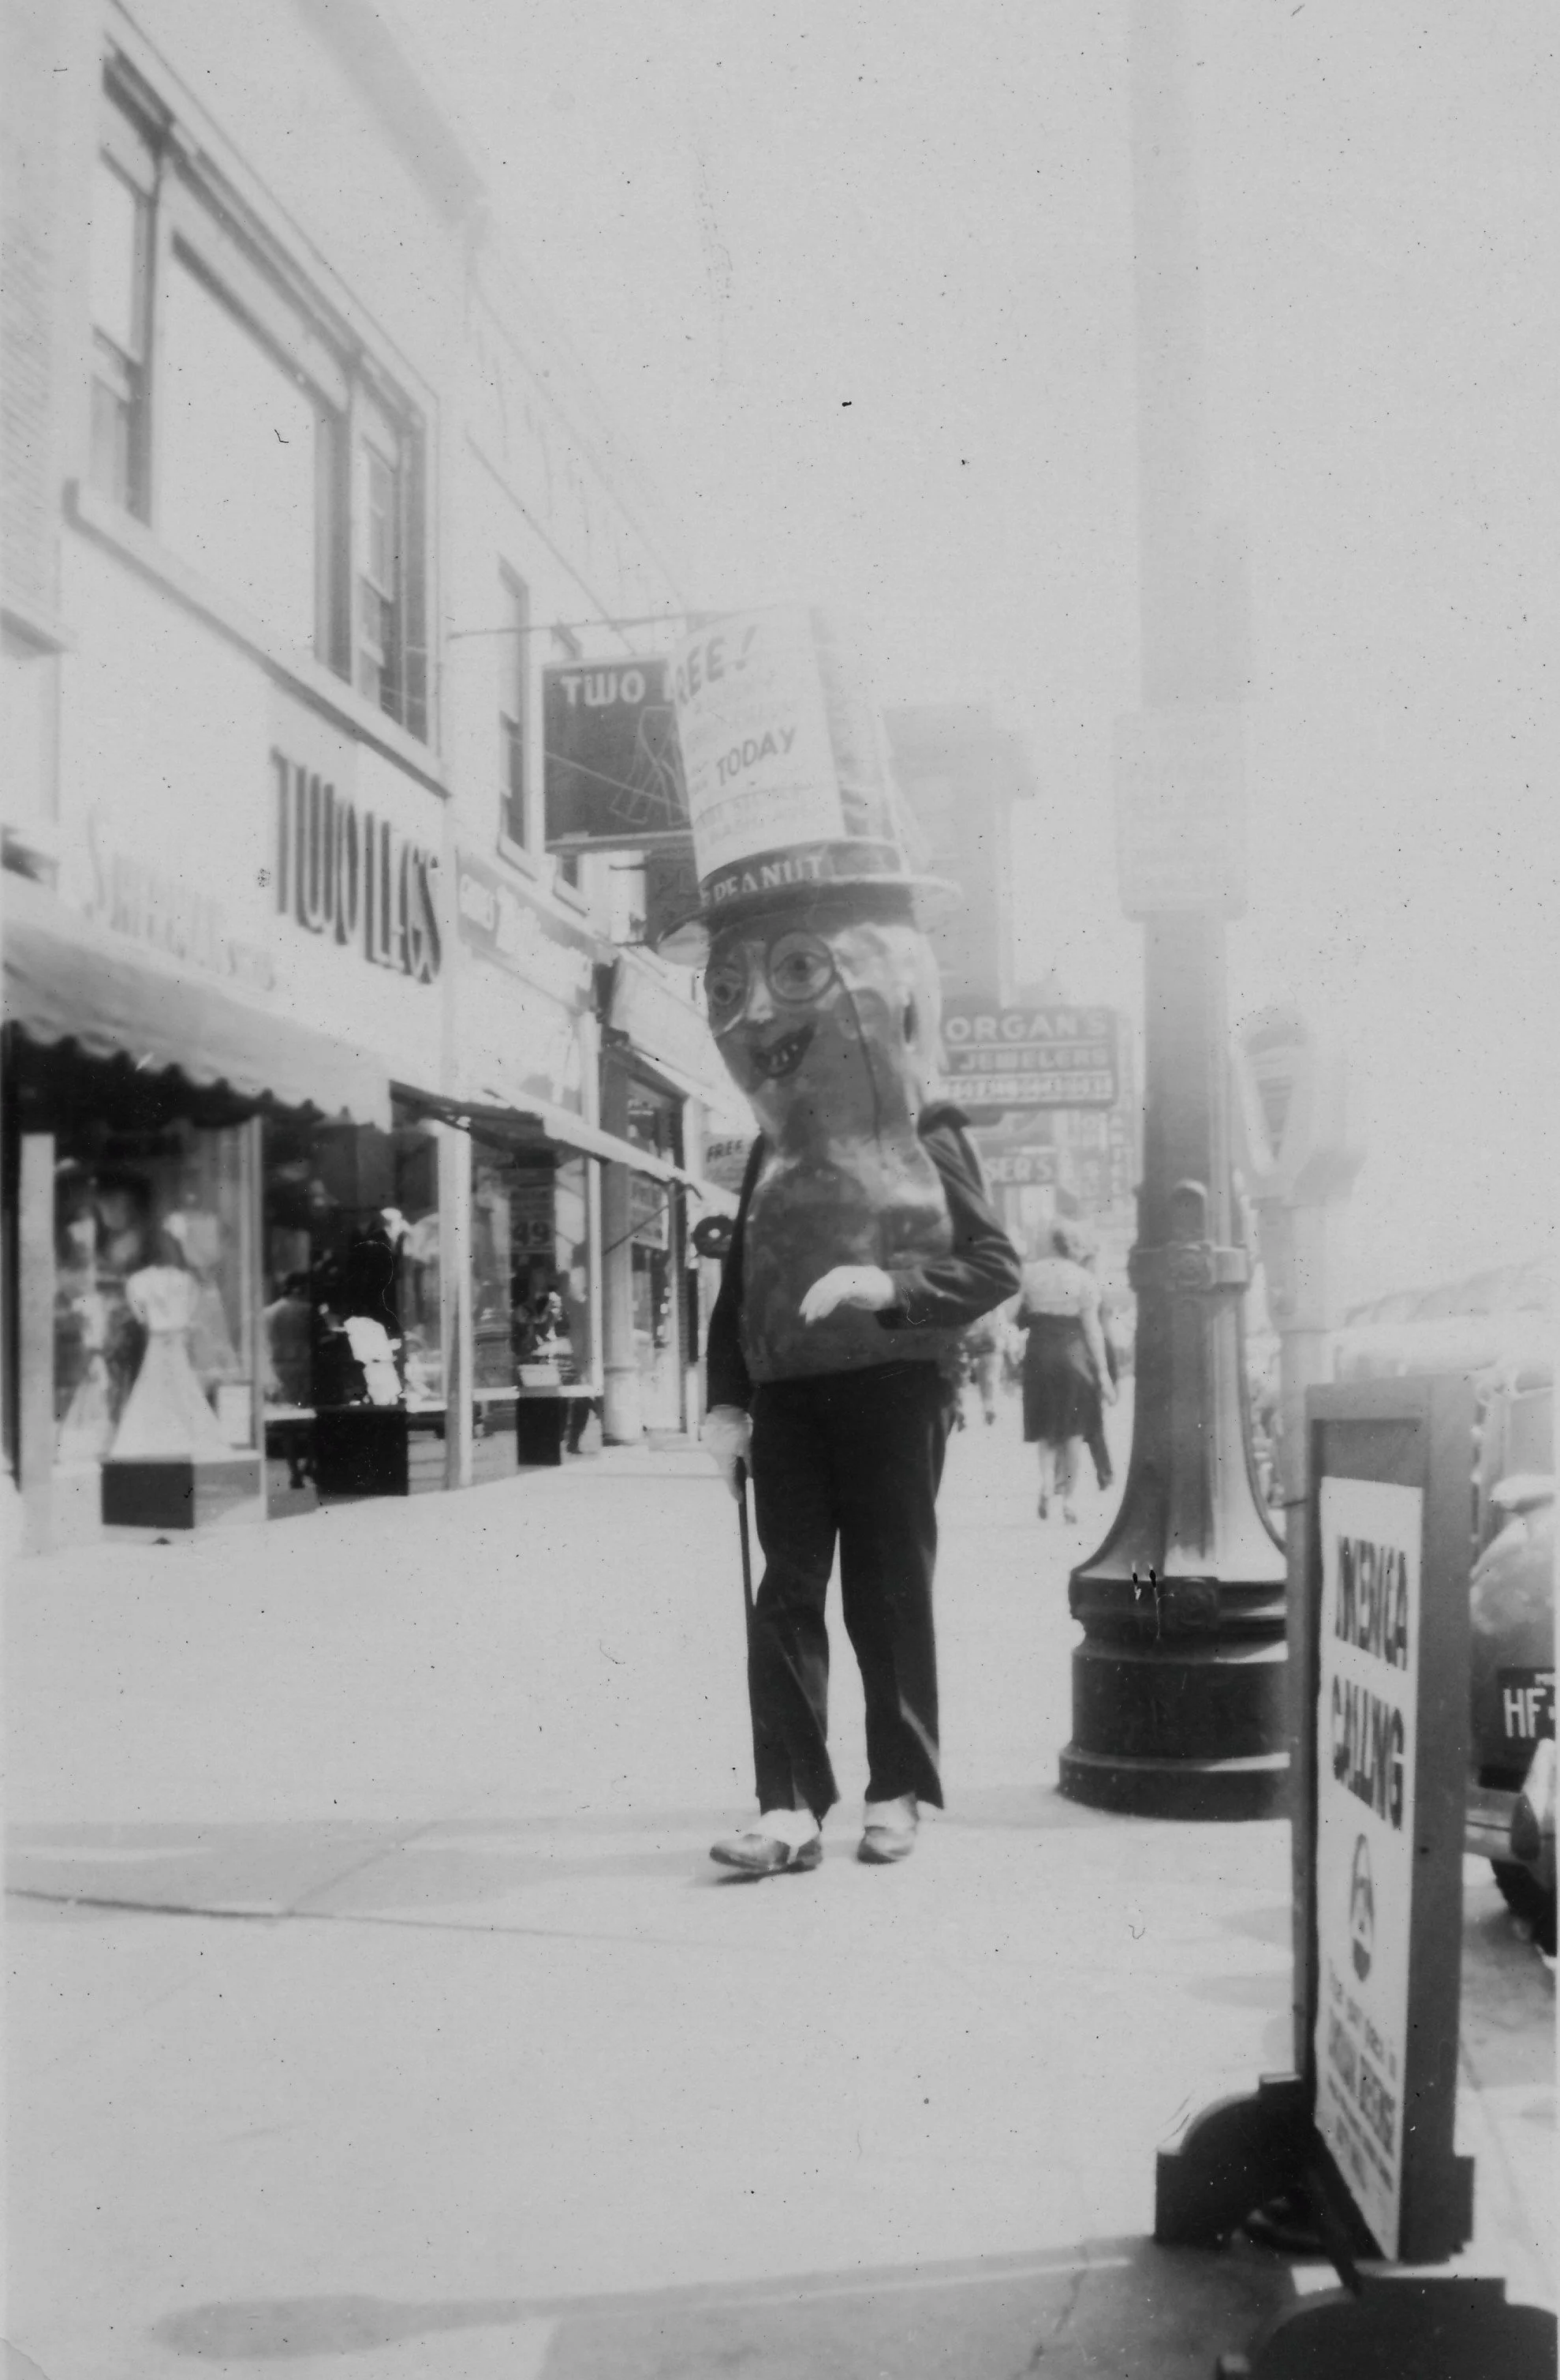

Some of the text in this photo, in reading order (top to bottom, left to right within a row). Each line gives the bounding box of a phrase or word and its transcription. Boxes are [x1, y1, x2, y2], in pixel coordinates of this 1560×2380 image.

[559, 669, 646, 707] TWO
[676, 624, 757, 707] REE!
[715, 725, 796, 786] TODAY
[713, 854, 822, 904] PEANUT
[947, 1011, 1107, 1042] ORGAN'S
